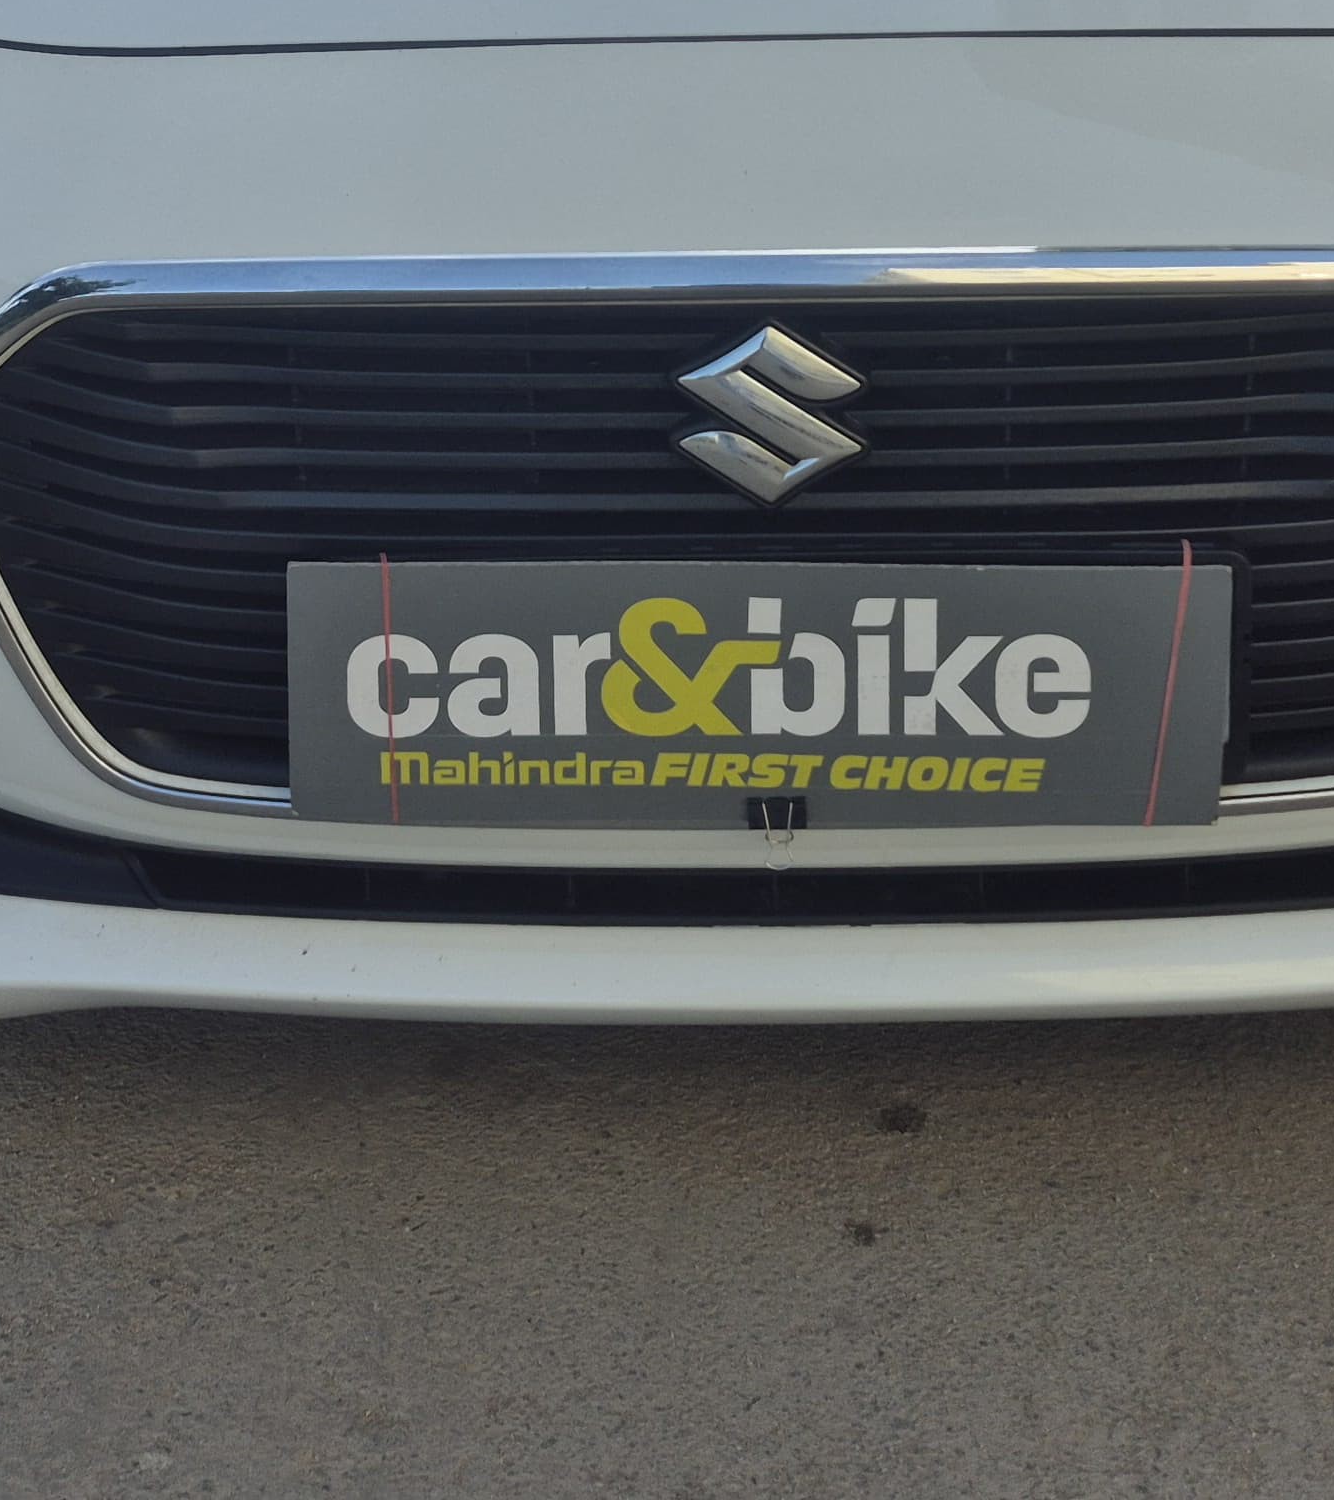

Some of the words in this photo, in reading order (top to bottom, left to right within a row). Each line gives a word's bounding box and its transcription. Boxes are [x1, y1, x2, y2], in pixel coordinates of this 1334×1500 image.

[380, 750, 646, 786] Mahindra
[649, 752, 825, 788] FIRST
[829, 754, 1046, 792] CHOICE
